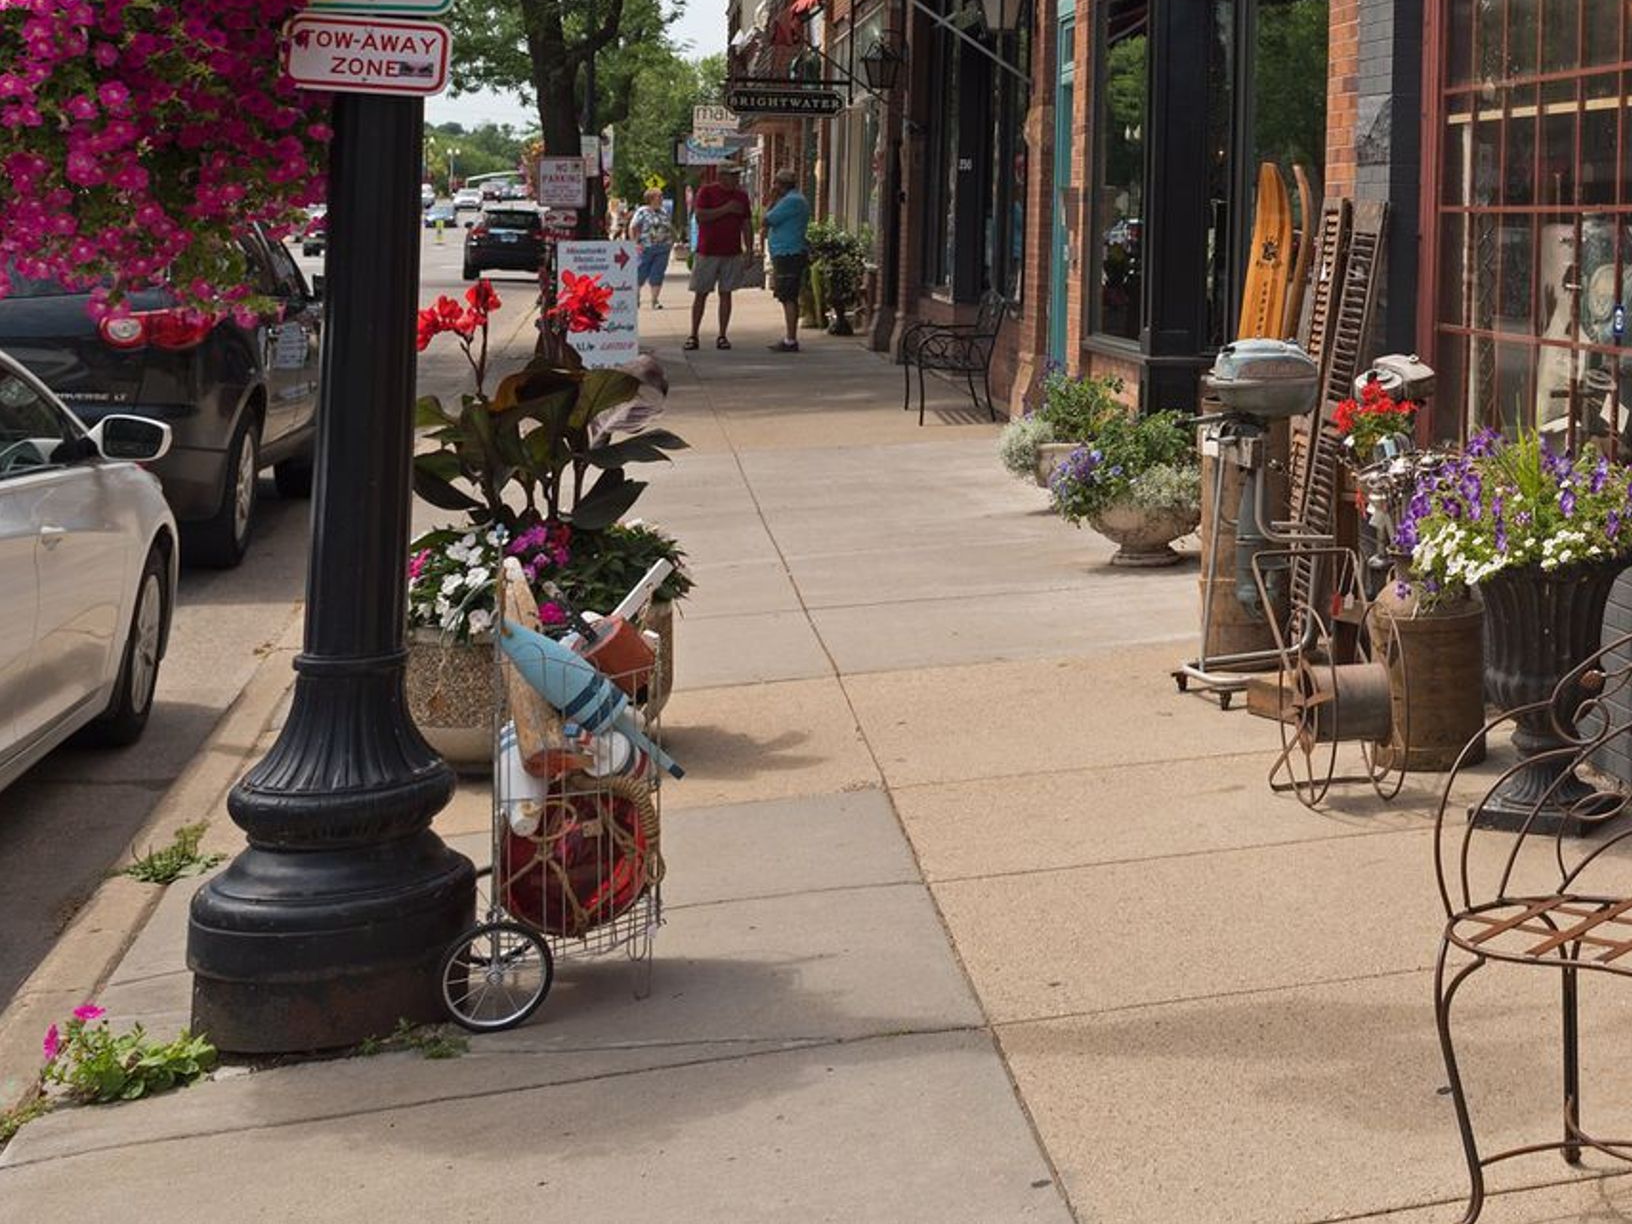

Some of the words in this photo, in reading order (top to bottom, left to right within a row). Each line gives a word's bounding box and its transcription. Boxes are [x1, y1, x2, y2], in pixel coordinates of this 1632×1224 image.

[330, 56, 400, 77] ZONE
[729, 96, 841, 110] BRIGHTWATER
[542, 175, 581, 183] PARKING
